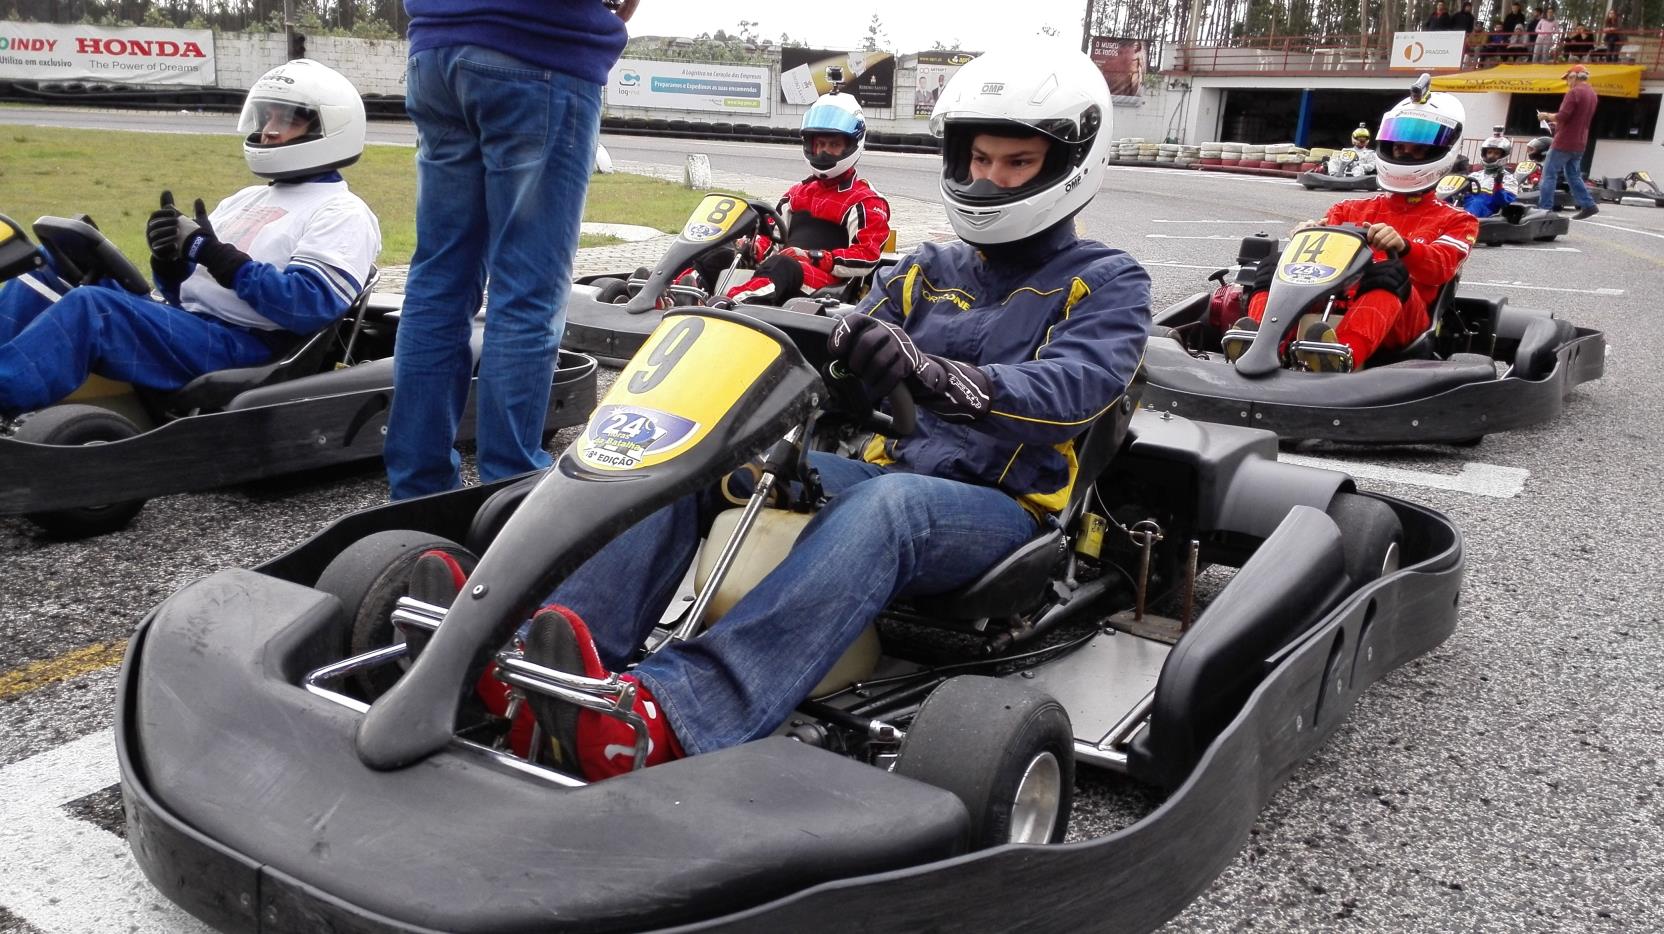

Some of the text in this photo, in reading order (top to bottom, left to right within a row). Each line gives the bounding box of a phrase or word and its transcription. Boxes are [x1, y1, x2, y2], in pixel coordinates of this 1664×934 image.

[75, 37, 207, 58] HONDA
[0, 56, 23, 65] Utiliza
[39, 58, 72, 68] exclusivo
[89, 59, 199, 73] The Power of Dreams
[981, 84, 1004, 94] OMP
[1064, 174, 1082, 193] OMP
[706, 199, 736, 224] 8
[1291, 233, 1330, 263] 14
[627, 316, 706, 395] 9
[602, 414, 647, 438] 24
[607, 437, 641, 451] Batalha
[597, 453, 634, 466] EDIÇÃO
